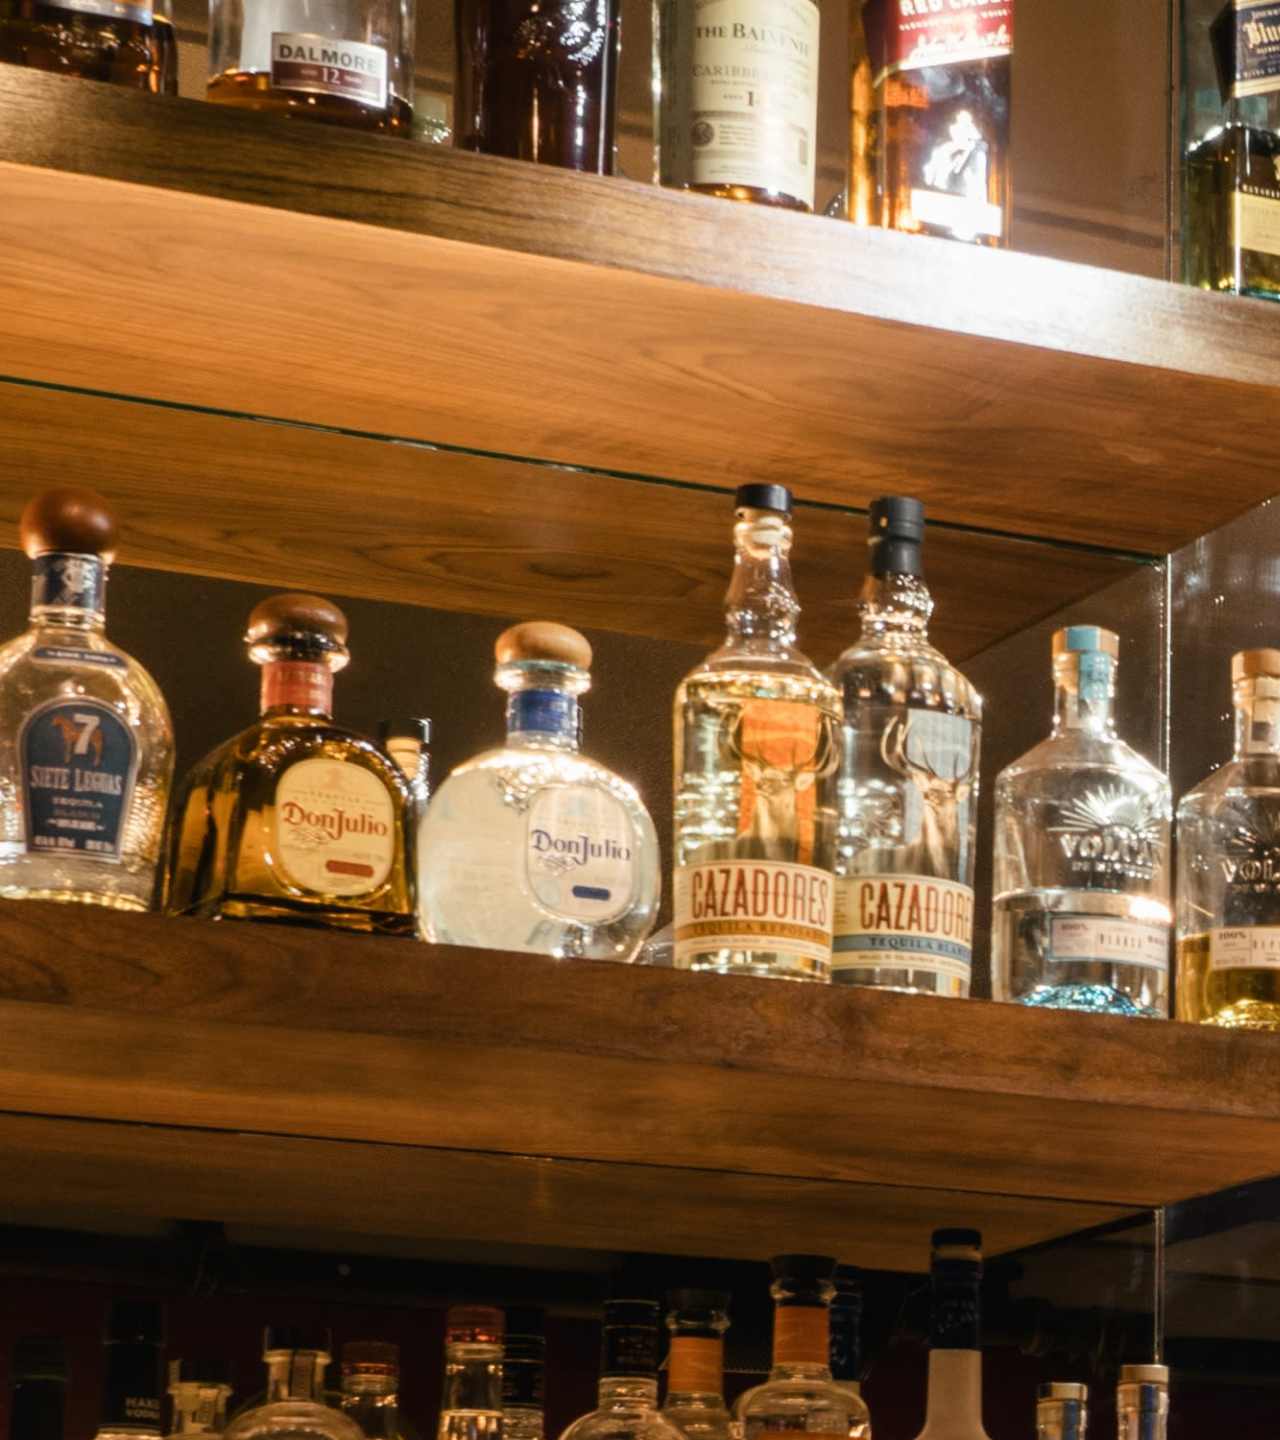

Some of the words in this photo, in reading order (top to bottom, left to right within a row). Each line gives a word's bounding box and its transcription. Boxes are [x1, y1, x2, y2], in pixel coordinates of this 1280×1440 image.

[696, 24, 727, 40] THE
[278, 42, 378, 75] DALMORE
[321, 66, 340, 84] 12
[73, 713, 99, 755] 7
[30, 766, 71, 790] SIETE
[74, 768, 122, 795] LEGUAS
[283, 800, 334, 830] Don
[326, 806, 388, 841] Julio
[531, 828, 583, 858] Don
[575, 834, 632, 868] Julio
[691, 868, 828, 926] CAZADORES
[868, 936, 933, 952] TEQUILA
